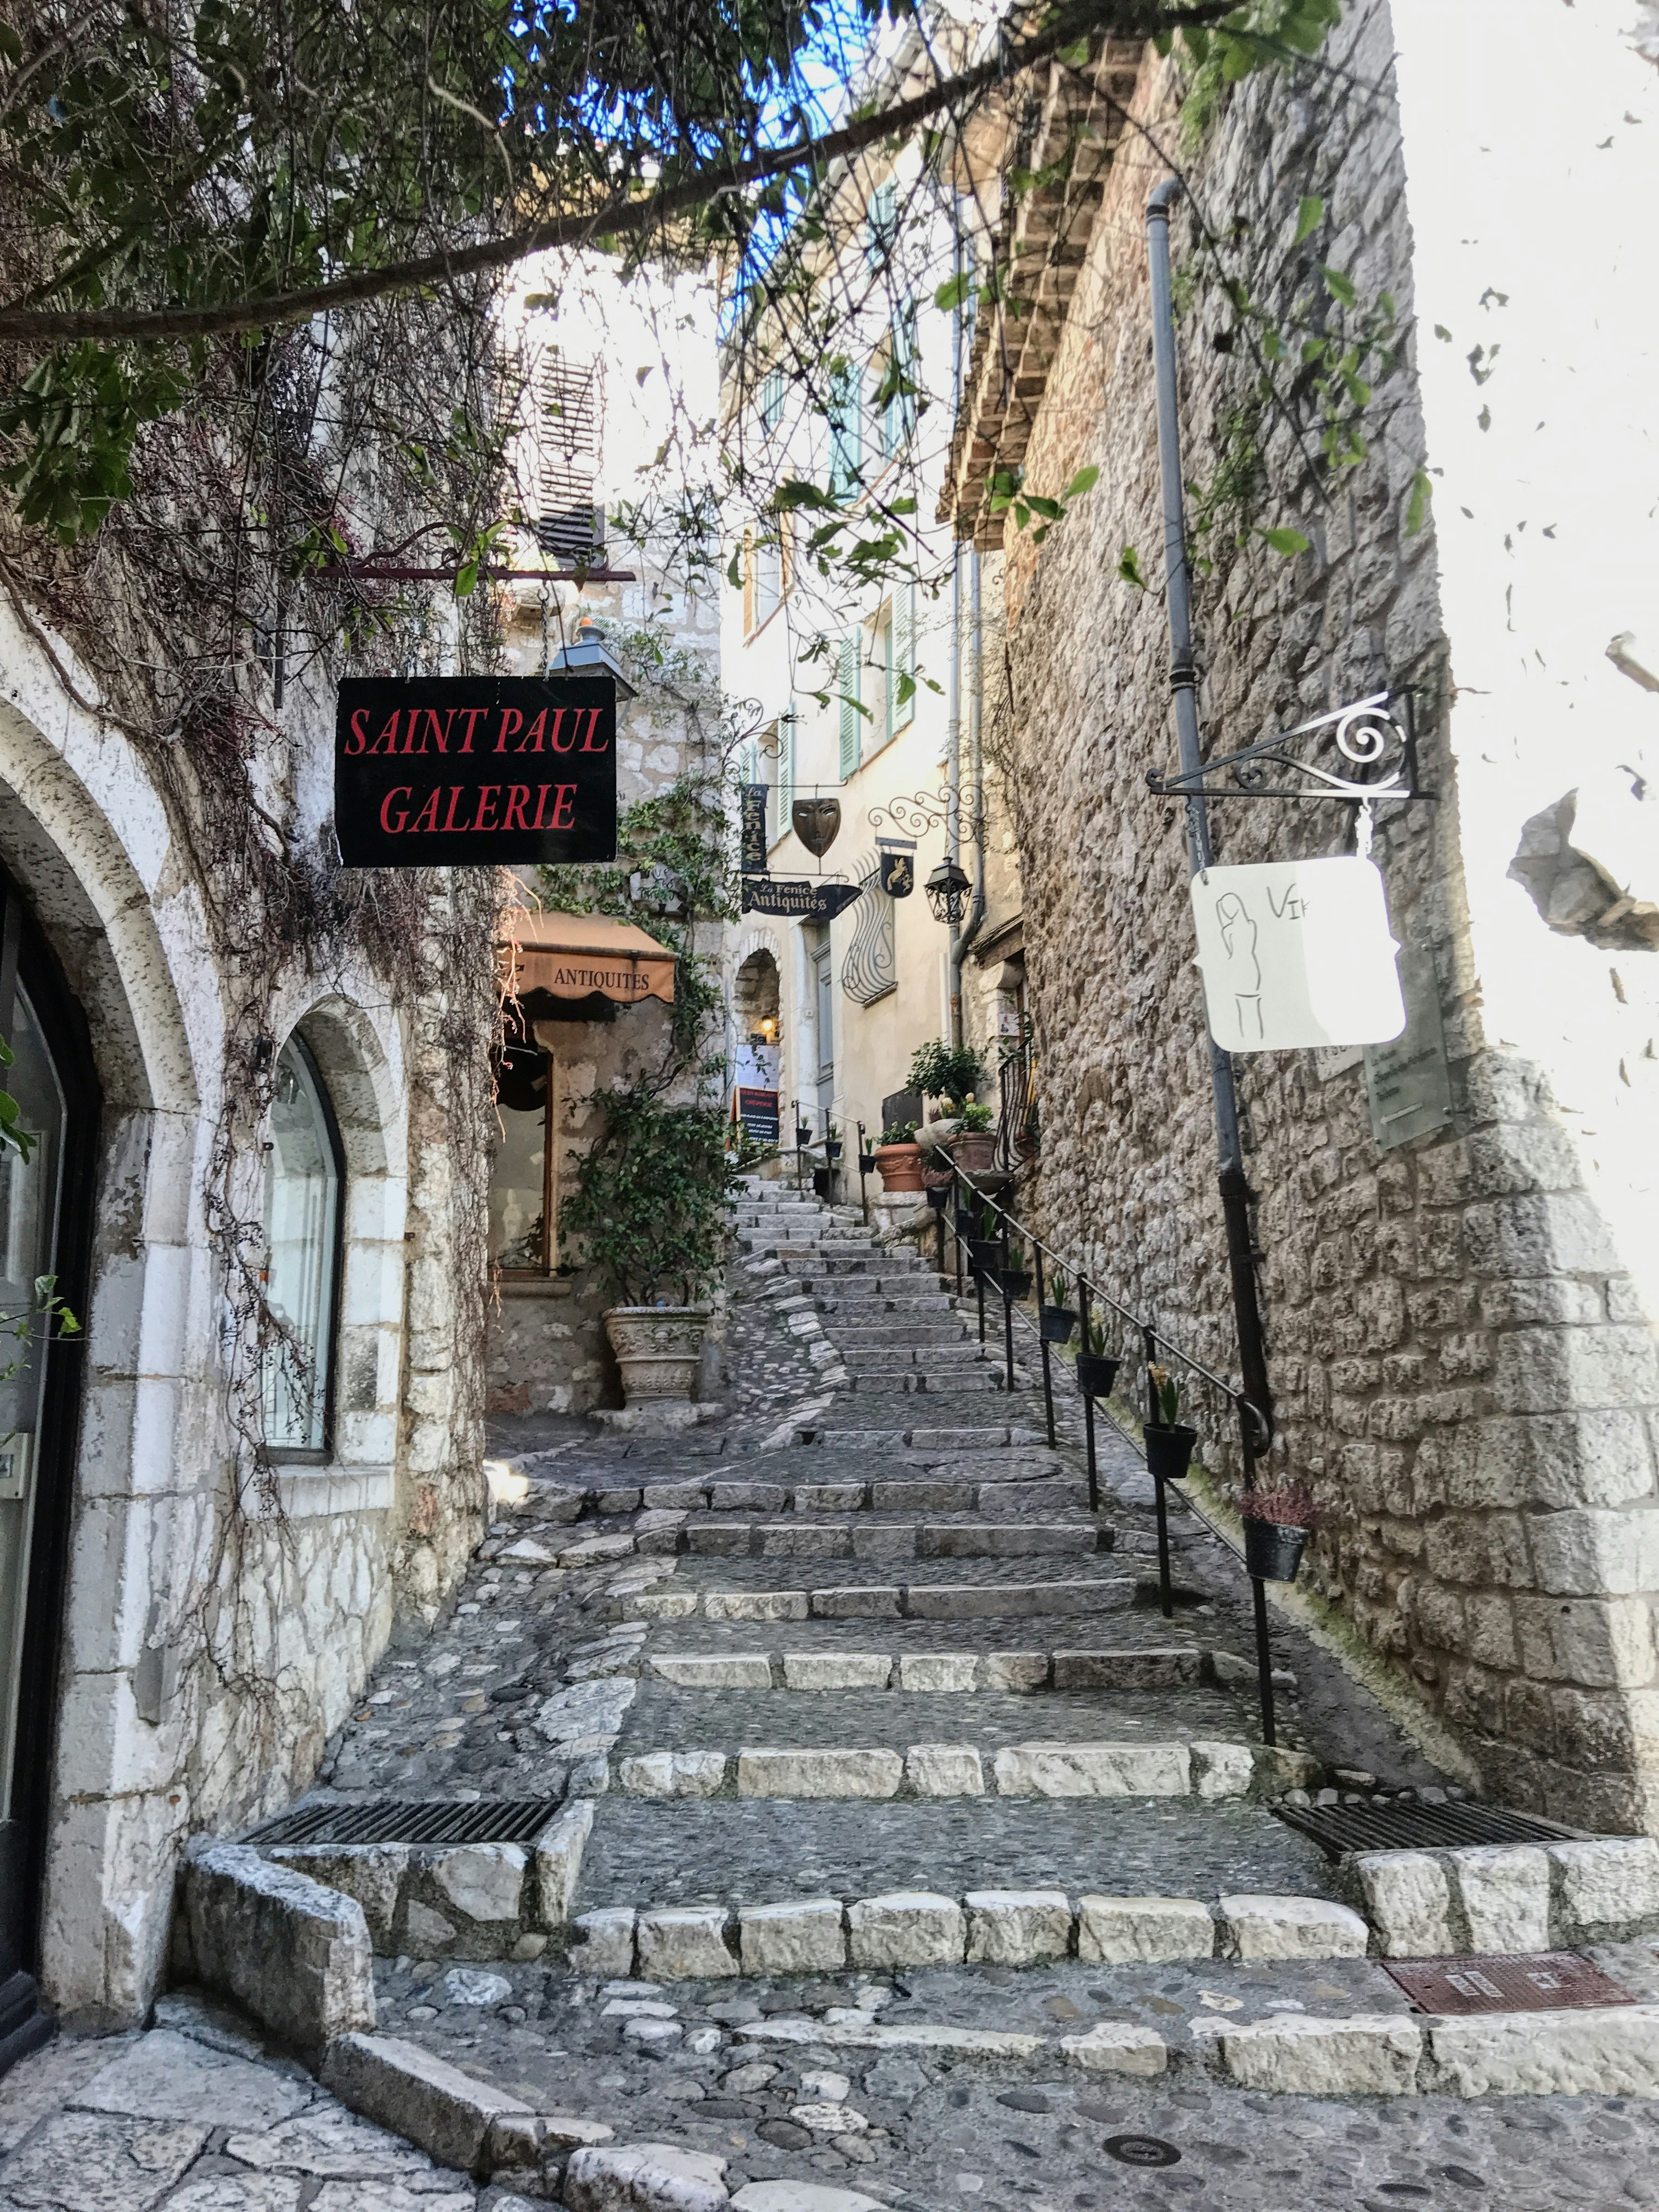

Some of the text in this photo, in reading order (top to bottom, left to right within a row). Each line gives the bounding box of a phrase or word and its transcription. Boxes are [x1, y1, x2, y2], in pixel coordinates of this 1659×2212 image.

[344, 707, 609, 755] SAINT PAUL
[380, 783, 578, 833] GALERIE
[743, 786, 762, 861] La Fenice
[747, 890, 827, 913] Antiquités
[759, 884, 817, 895] La Fenice
[554, 967, 650, 991] ANTIQUITES
